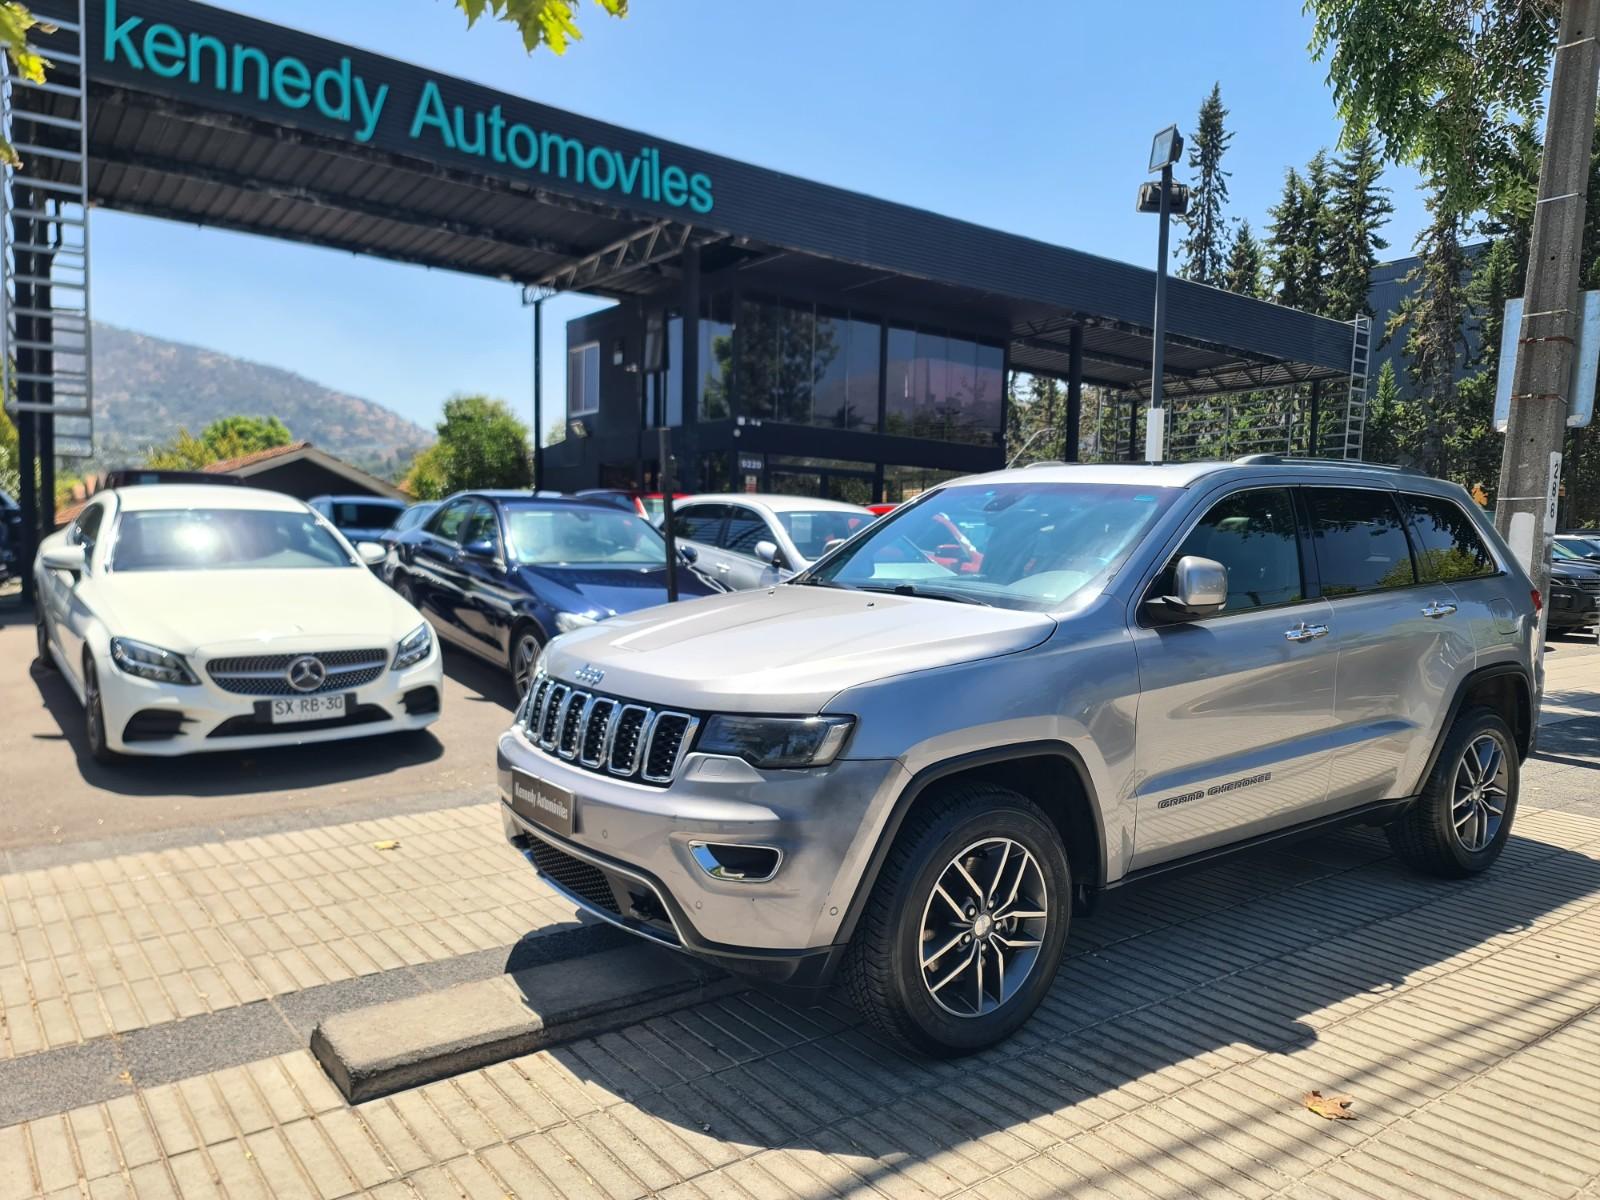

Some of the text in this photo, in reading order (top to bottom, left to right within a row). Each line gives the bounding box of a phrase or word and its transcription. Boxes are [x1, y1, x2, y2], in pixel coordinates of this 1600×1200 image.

[104, 0, 714, 214] kennedy Automoviles
[515, 782, 537, 808] Kennedy
[1158, 772, 1272, 809] GRAND CHEROKEE
